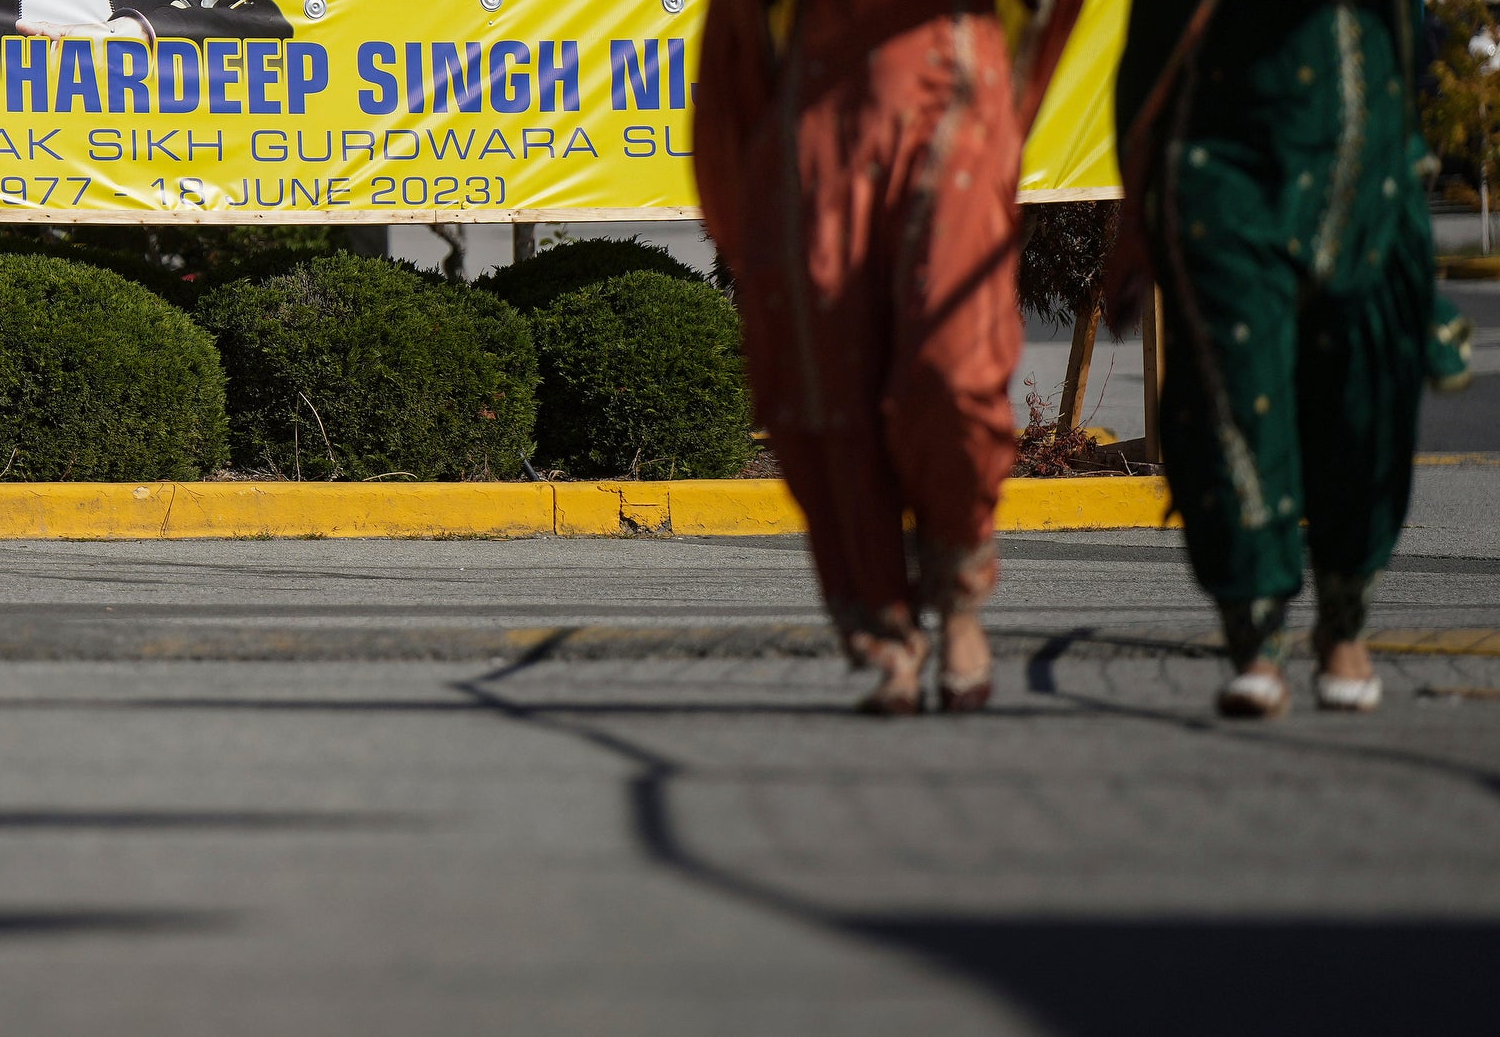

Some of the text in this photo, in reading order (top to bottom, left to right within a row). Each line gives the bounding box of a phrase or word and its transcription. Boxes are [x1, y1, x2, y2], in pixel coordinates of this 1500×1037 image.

[4, 38, 329, 114] HARDEEP
[359, 40, 580, 114] SINGH
[88, 128, 223, 161] SIKH
[251, 127, 599, 162] GURDWARA
[150, 177, 206, 206] 18
[225, 177, 351, 206] JUNE
[371, 175, 505, 205] 2023)
